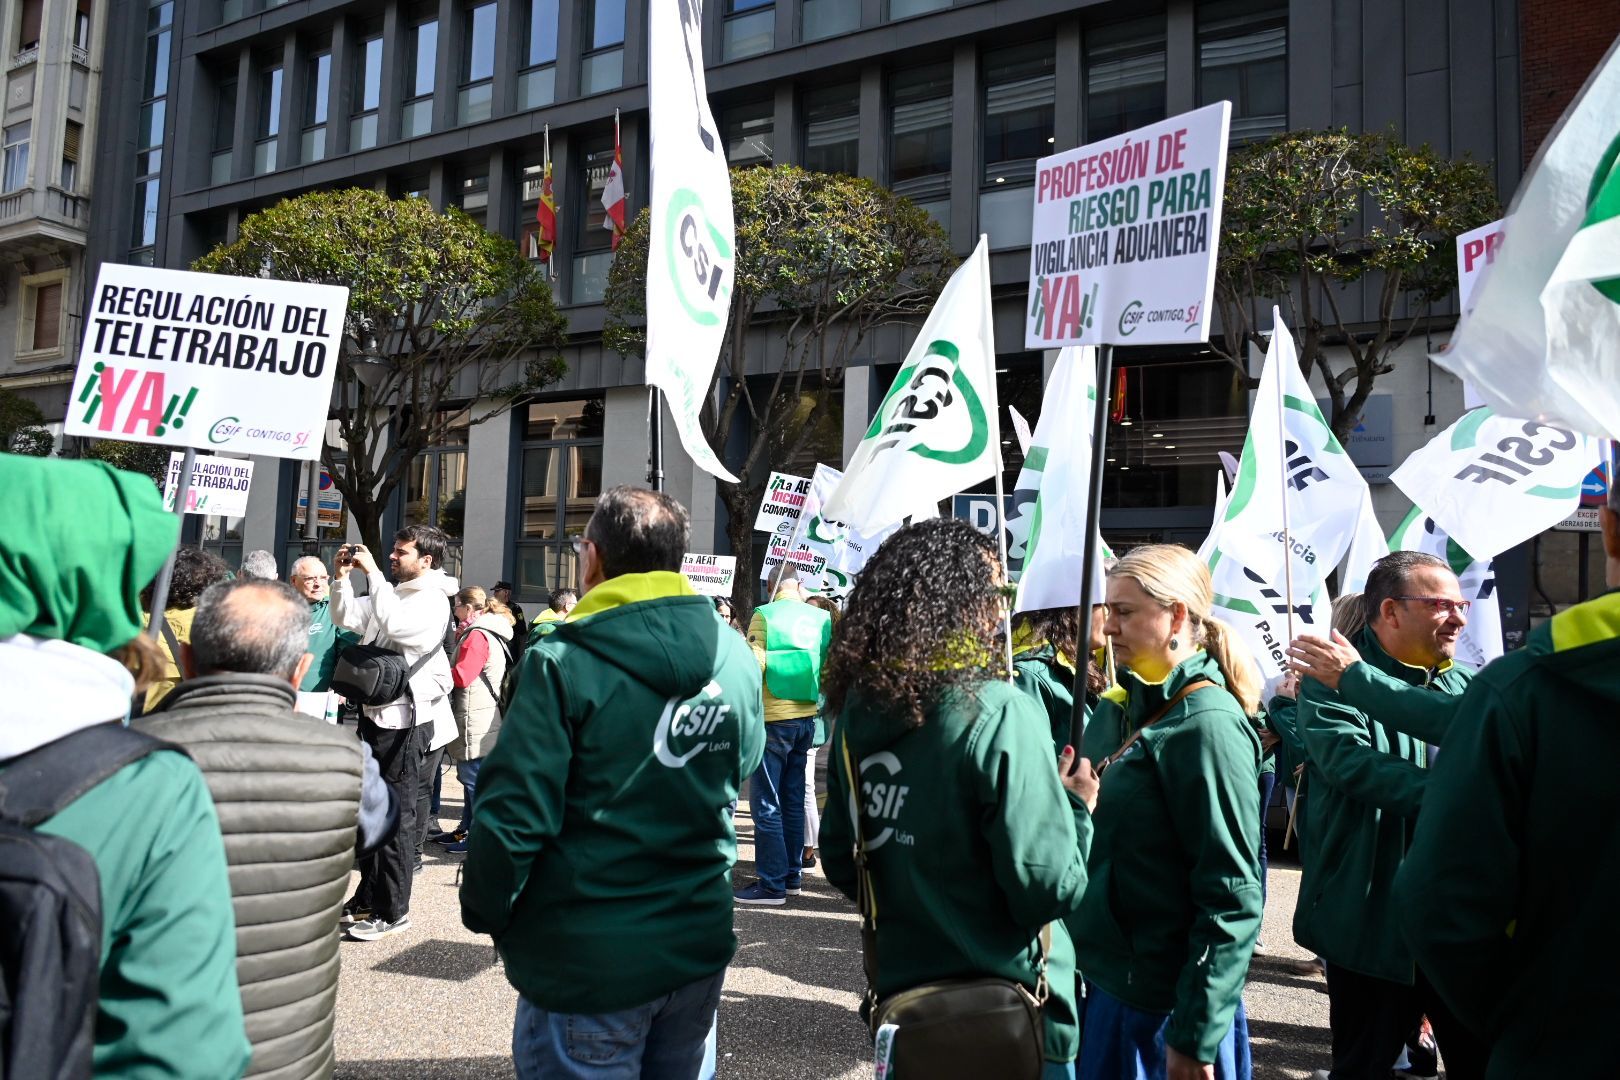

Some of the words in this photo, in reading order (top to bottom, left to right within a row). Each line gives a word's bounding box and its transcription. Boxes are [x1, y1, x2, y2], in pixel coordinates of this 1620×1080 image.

[1038, 139, 1150, 203] PROFESIÓN
[1155, 128, 1187, 174] DE
[1068, 185, 1140, 235] RIESGO
[1147, 168, 1211, 219] PARA
[680, 214, 723, 301] CSI
[1035, 231, 1108, 276] VIGILANCIA
[1113, 212, 1207, 265] ADUANERA
[98, 284, 275, 331] REGULACIÓN
[281, 304, 330, 337] DEL
[92, 318, 328, 378] TELETRABAJO
[78, 361, 199, 437] ¡¡YA!!
[234, 467, 250, 478] DEL
[795, 480, 811, 495] AE
[762, 503, 800, 520] COMPRO
[1584, 520, 1593, 528] DE
[681, 565, 720, 575] ncumple
[696, 556, 718, 566] AEAT
[813, 555, 826, 563] sus
[671, 704, 731, 737] CSIF
[708, 741, 731, 752] León
[862, 781, 910, 820] CSIF
